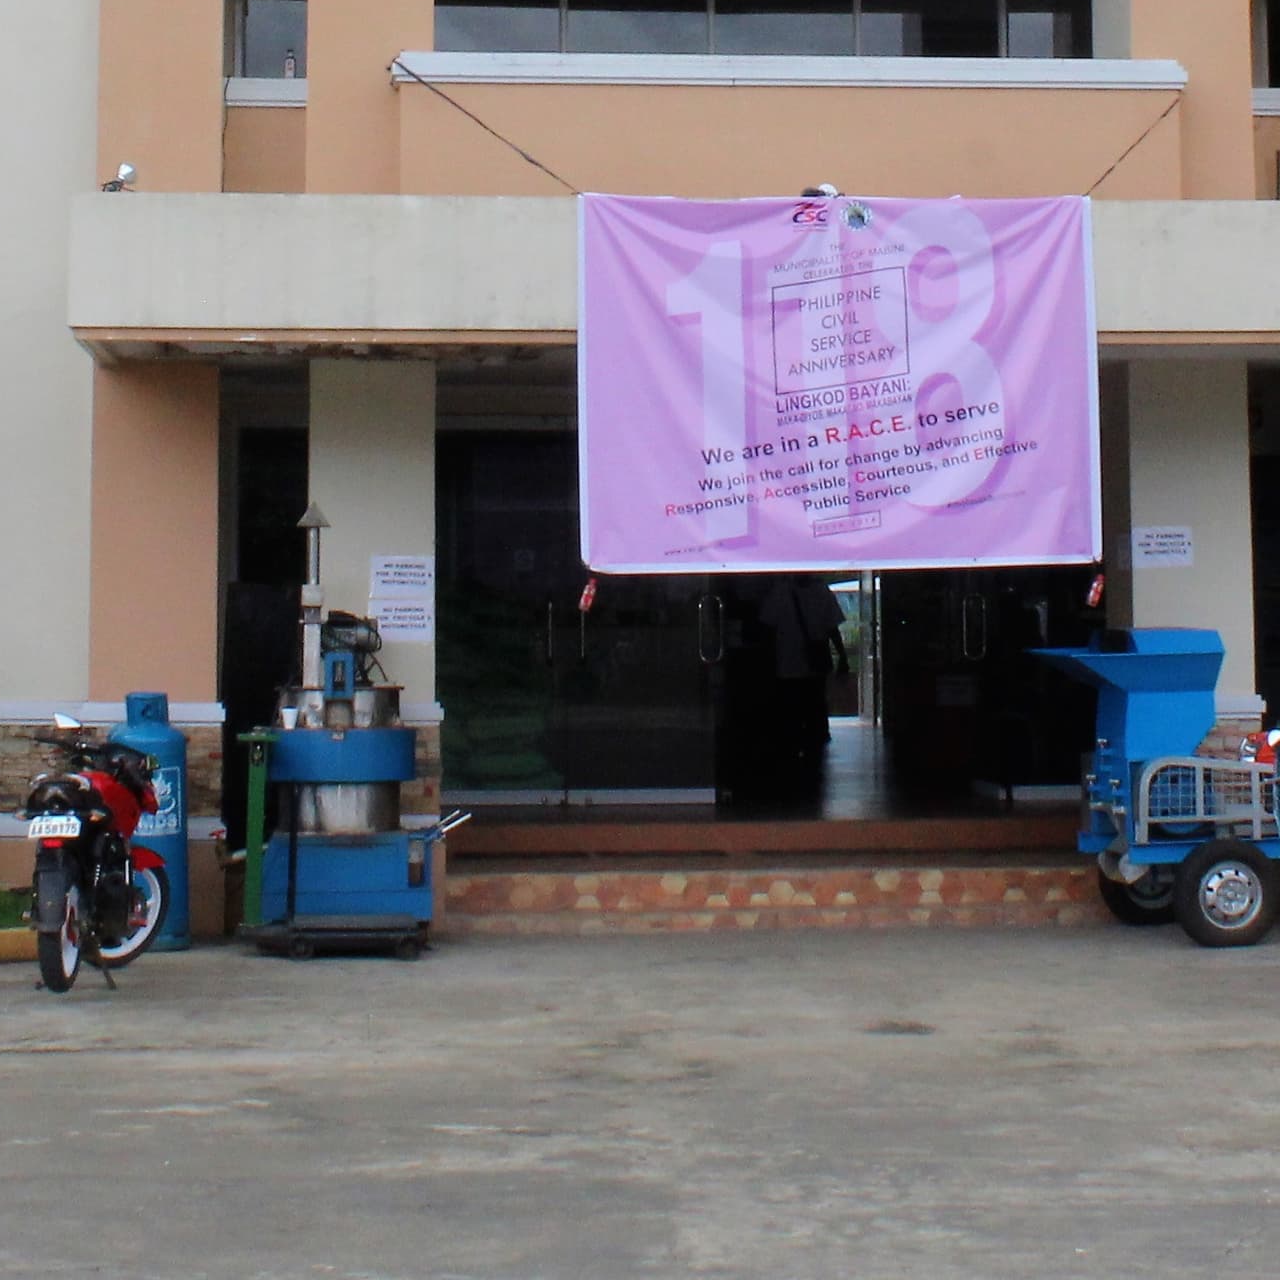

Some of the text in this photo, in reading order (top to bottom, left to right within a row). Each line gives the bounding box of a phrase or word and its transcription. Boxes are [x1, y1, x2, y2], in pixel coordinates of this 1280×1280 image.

[792, 209, 828, 224] CSC
[773, 253, 850, 274] MUNICIPALITY
[799, 286, 881, 312] PHILIPPINE
[821, 312, 860, 329] CIVIL
[810, 330, 872, 352] SERVICE
[788, 346, 896, 377] ANNIVERSARY
[776, 378, 911, 414] LINGKOD BAYANI:
[701, 401, 1000, 466] We are in a R.A.C.E. to serve
[698, 427, 1004, 492] We join the call for change by advancing
[665, 439, 1038, 517] Responsive, Accessible, Courteous, and Effective
[802, 484, 912, 512] Public Service
